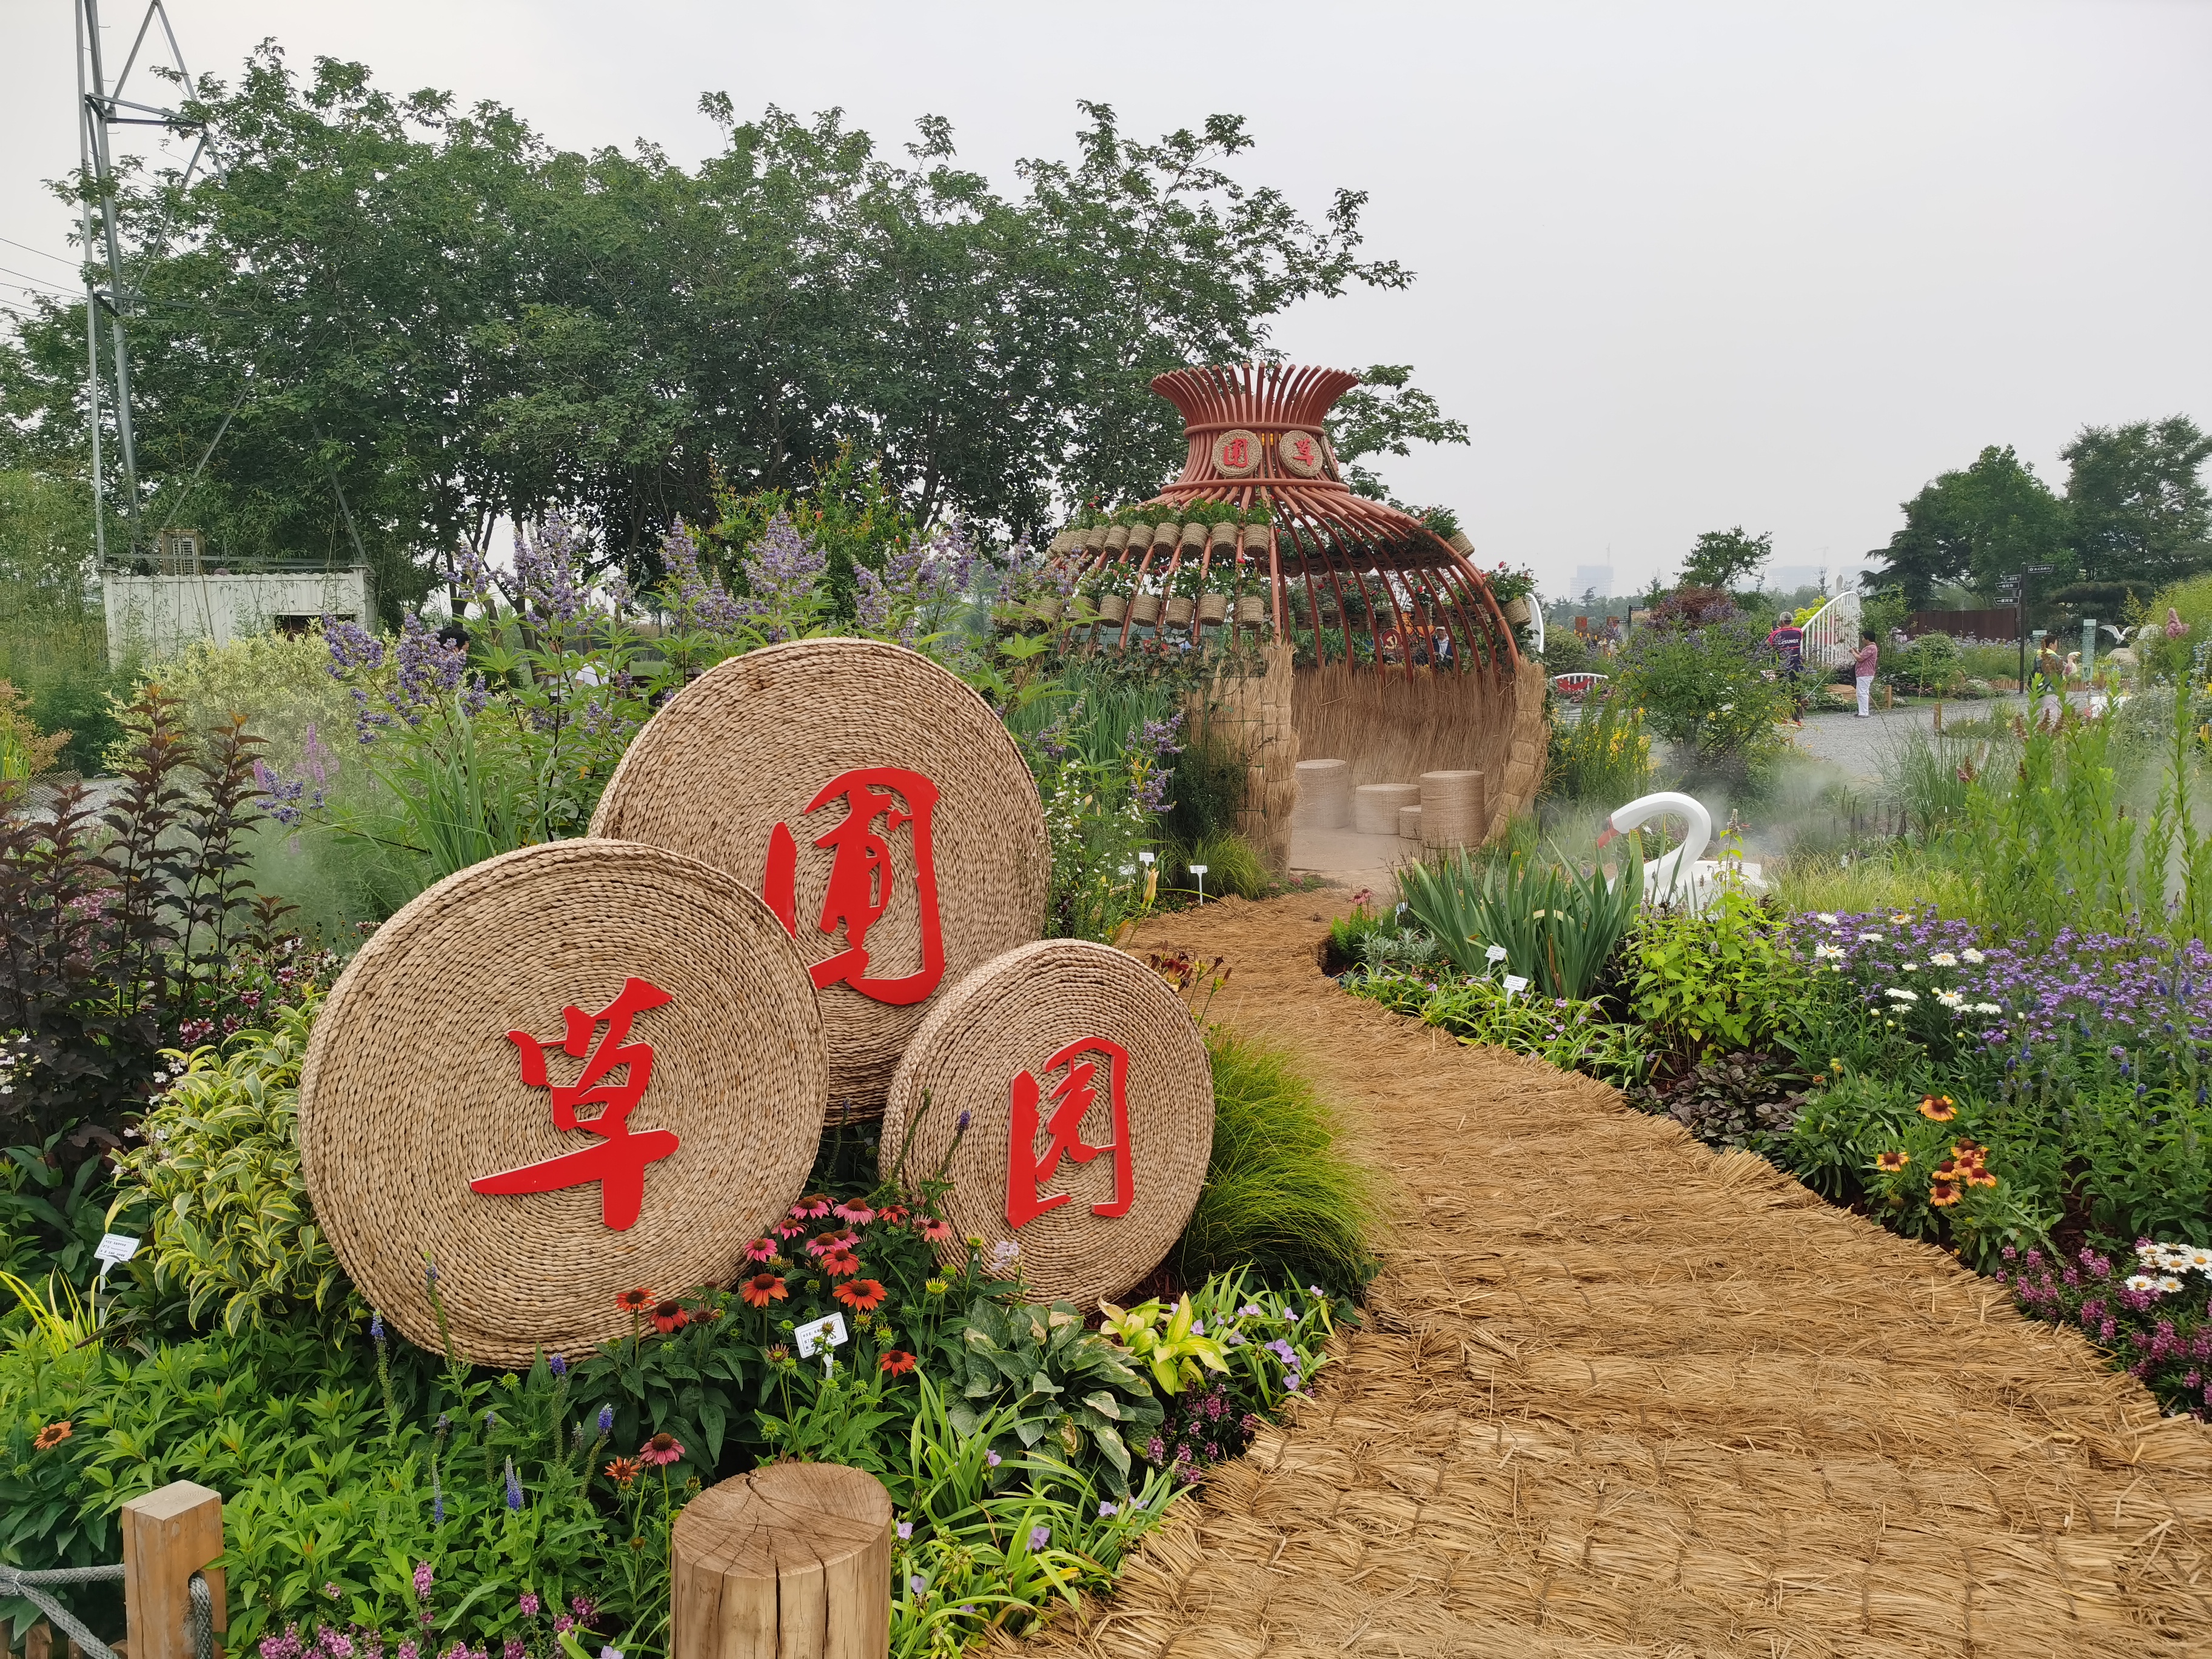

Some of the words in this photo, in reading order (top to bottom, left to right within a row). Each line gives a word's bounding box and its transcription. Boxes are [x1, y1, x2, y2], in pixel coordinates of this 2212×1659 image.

[1293, 438, 1315, 466] 草
[471, 977, 680, 1232] 草
[1006, 1036, 1134, 1231] 园
